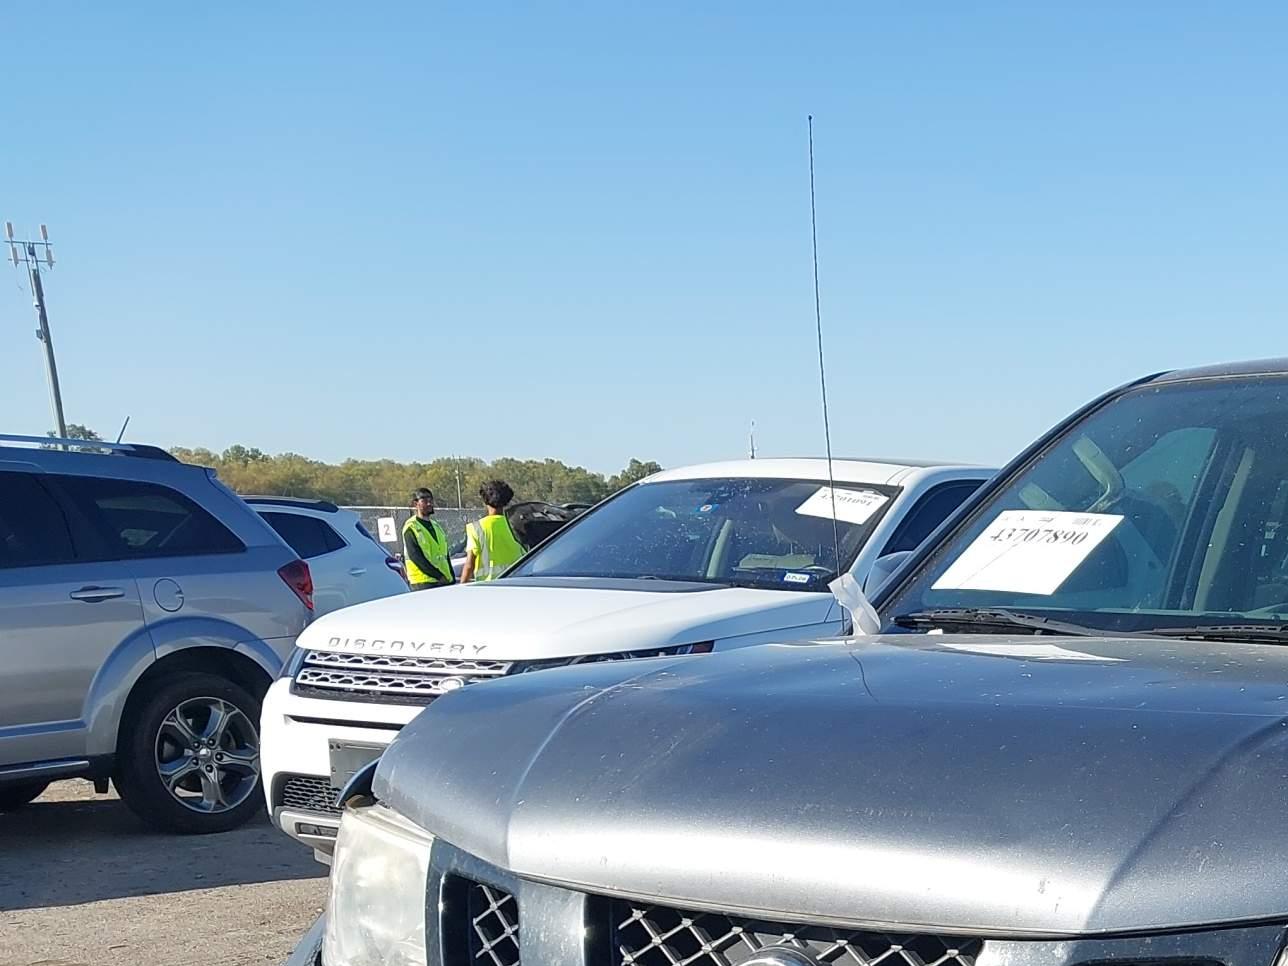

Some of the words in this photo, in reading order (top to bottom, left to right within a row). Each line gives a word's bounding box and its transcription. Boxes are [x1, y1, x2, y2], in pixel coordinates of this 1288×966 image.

[383, 523, 391, 536] 2
[990, 528, 1089, 545] 43707890
[328, 637, 488, 654] DISCOVERY
